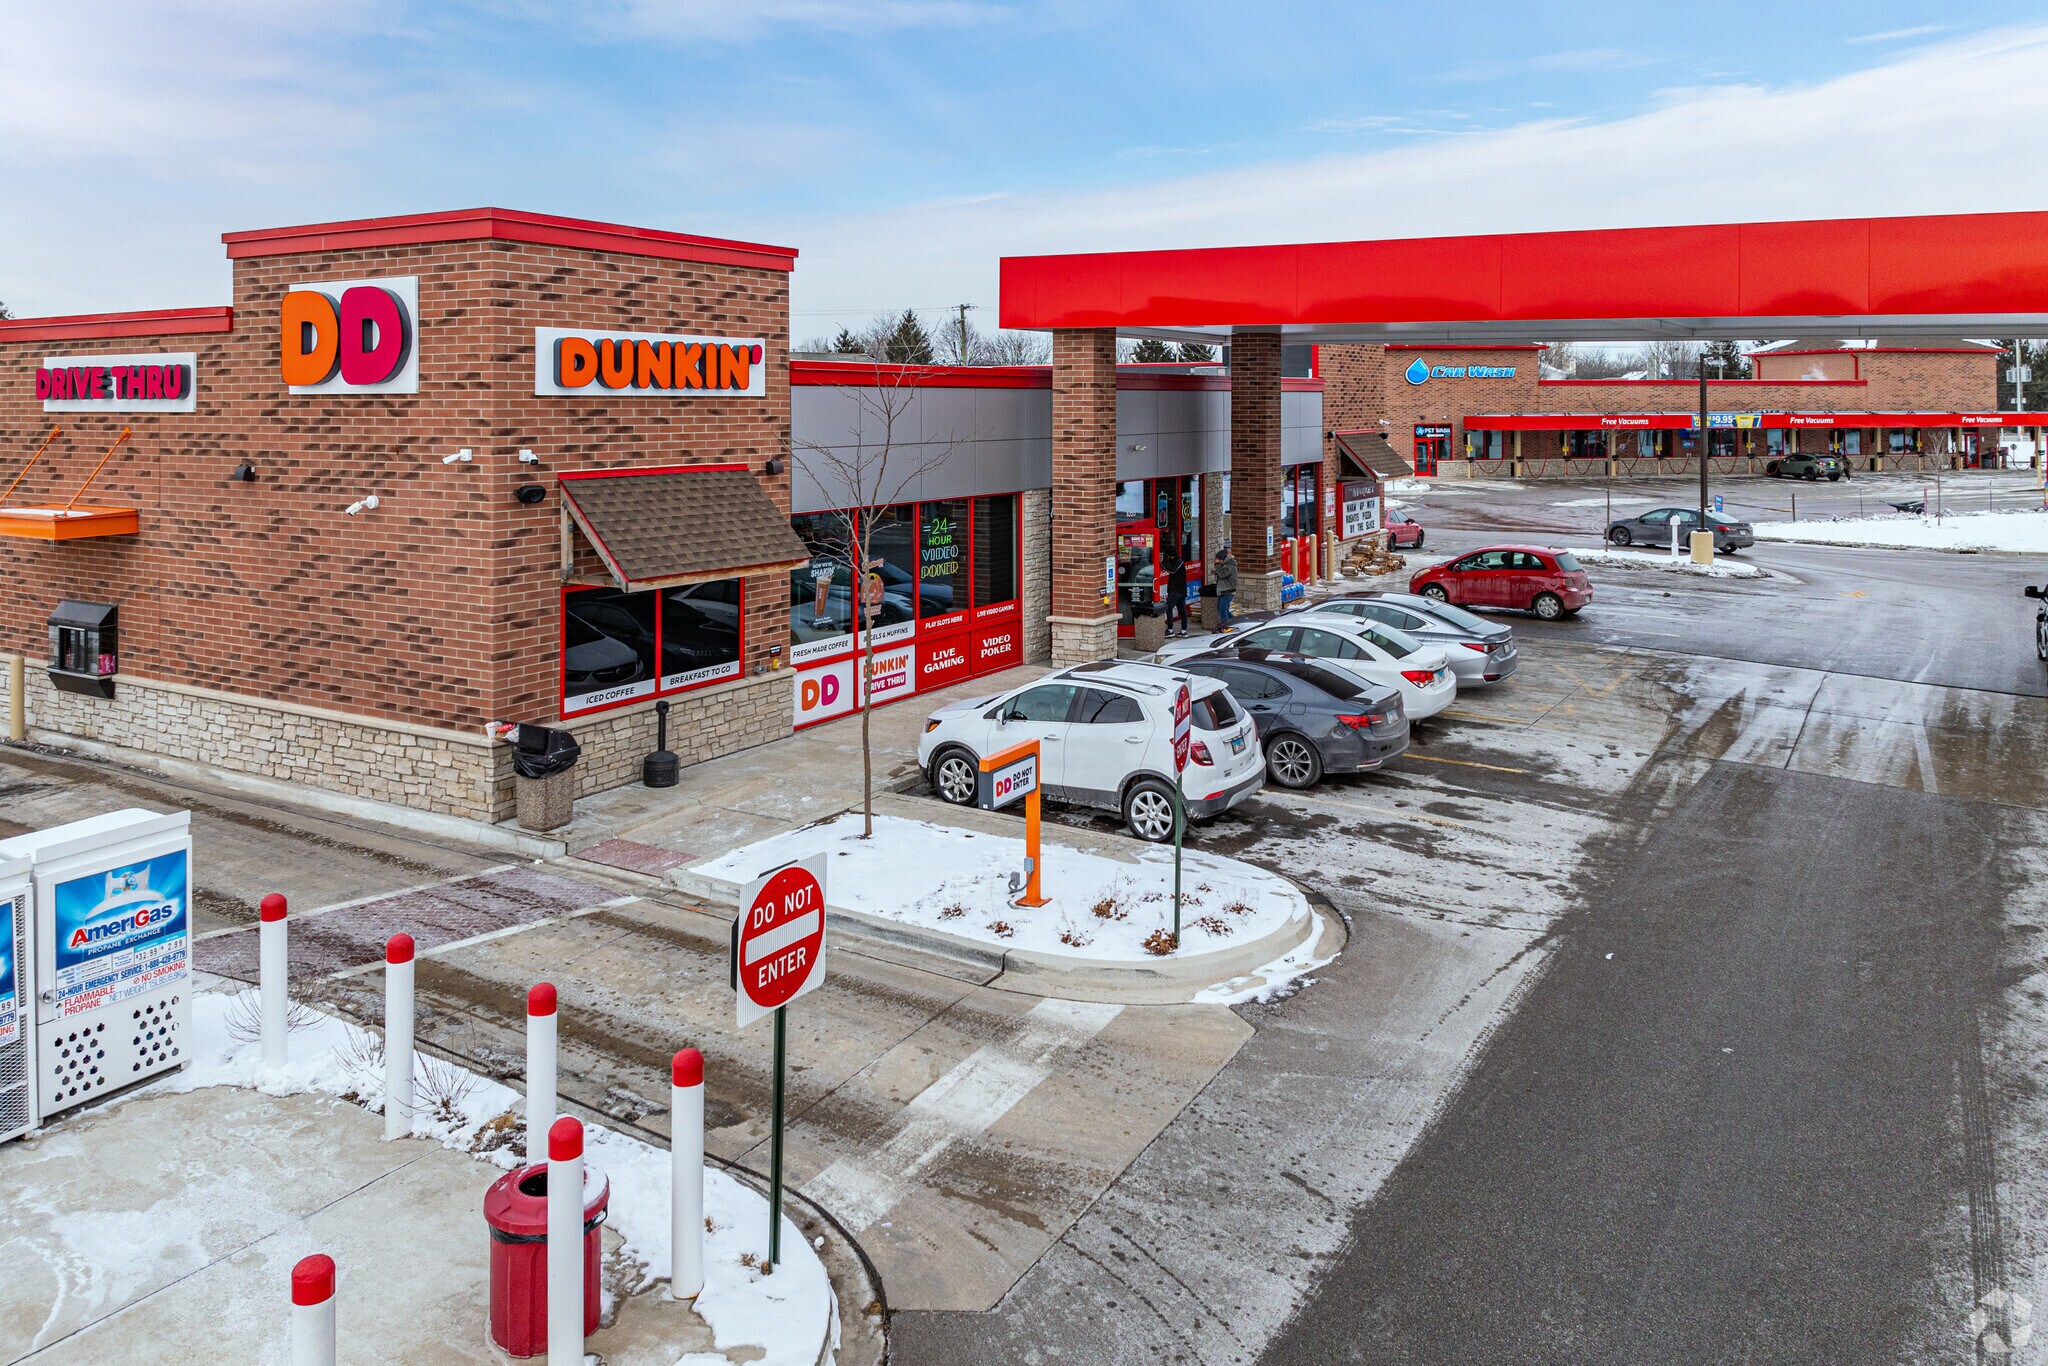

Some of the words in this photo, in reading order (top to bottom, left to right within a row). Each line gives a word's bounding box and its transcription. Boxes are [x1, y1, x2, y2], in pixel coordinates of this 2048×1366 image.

[281, 286, 406, 386] DD
[559, 337, 762, 390] DUNKIN'
[36, 366, 103, 400] DRIVE
[111, 364, 183, 399] THRU
[932, 517, 948, 535] 24
[928, 535, 952, 546] HOUR
[922, 545, 958, 561] VIDEO
[811, 566, 835, 578] SHAKIN'
[921, 561, 958, 578] POKER
[977, 610, 985, 618] LIVE
[986, 607, 998, 615] VIDEO
[999, 604, 1014, 612] GAMING
[925, 621, 936, 629] PLAY
[937, 618, 950, 627] SLOTS
[951, 615, 963, 623] HERE
[863, 633, 881, 642] BGELS
[887, 627, 908, 637] MUFFINS
[982, 634, 1011, 648] VIDEO
[793, 648, 811, 658] FRESH
[812, 645, 827, 654] MADE
[828, 640, 848, 650] COFFEE
[932, 647, 956, 661] LIVE
[981, 643, 1011, 659] POKER
[923, 655, 965, 674] GAMING
[670, 670, 710, 685] BREAKFAST
[711, 668, 720, 676] TO
[721, 665, 731, 674] GO
[870, 680, 885, 691] RIVE
[887, 674, 905, 686] THRU
[586, 694, 604, 704] ICED
[605, 687, 635, 700] COFFEE
[801, 674, 839, 711] DD
[996, 777, 1012, 797] DD
[1013, 772, 1021, 782] DO
[1022, 766, 1032, 778] NOT
[1013, 777, 1029, 791] ENTER
[753, 901, 775, 930] DO
[784, 884, 814, 915] NOT
[88, 941, 122, 956] PROPANE
[125, 928, 161, 944] EXCHANGE
[142, 972, 152, 982] NO
[153, 960, 186, 978] SMOKING
[758, 946, 806, 988] ENTER
[58, 984, 83, 999] 24-HOUR
[85, 972, 119, 990] EMERGENCY
[121, 964, 144, 979] SERVICE:
[64, 984, 115, 1007] FLAMMABLE
[110, 990, 122, 1001] NET
[123, 983, 147, 997] WEIGHT
[64, 998, 101, 1017] PROPANE
